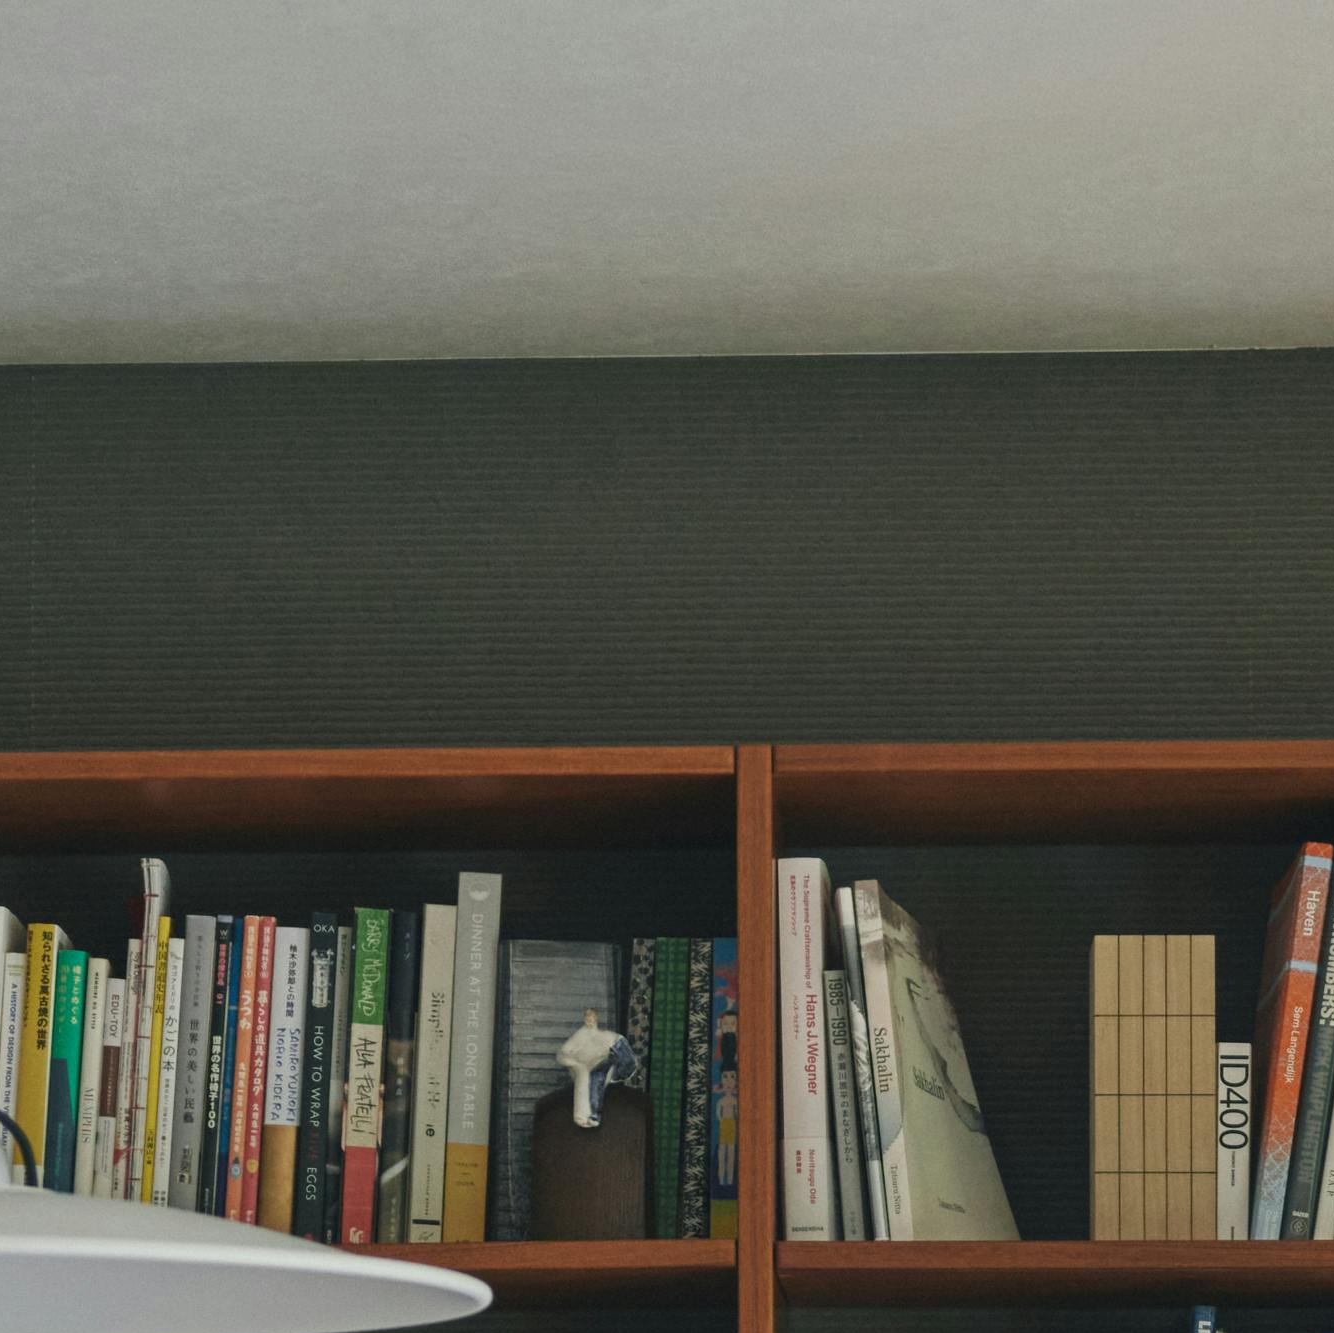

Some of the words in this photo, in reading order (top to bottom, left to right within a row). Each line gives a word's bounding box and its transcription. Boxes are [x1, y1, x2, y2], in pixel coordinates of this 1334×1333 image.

[1302, 890, 1321, 936] Haven
[469, 913, 484, 970] DINNER
[468, 976, 482, 996] AT
[109, 994, 120, 1038] EDU-TOY
[467, 1001, 481, 1028] THE
[805, 993, 819, 1026] Hans
[1290, 1006, 1304, 1028] Sem
[311, 1025, 323, 1059] HOW
[355, 1037, 377, 1067] ALLA
[464, 1034, 479, 1078] LONG
[873, 1027, 893, 1094] Sakhalin
[1284, 1031, 1301, 1084] Langendijk
[311, 1065, 322, 1082] TO
[309, 1088, 321, 1126] WRAP
[352, 1077, 375, 1136] FRATELLI
[462, 1084, 477, 1129] TABLE
[1219, 1055, 1249, 1150] ID400
[306, 1167, 317, 1201] EGGS
